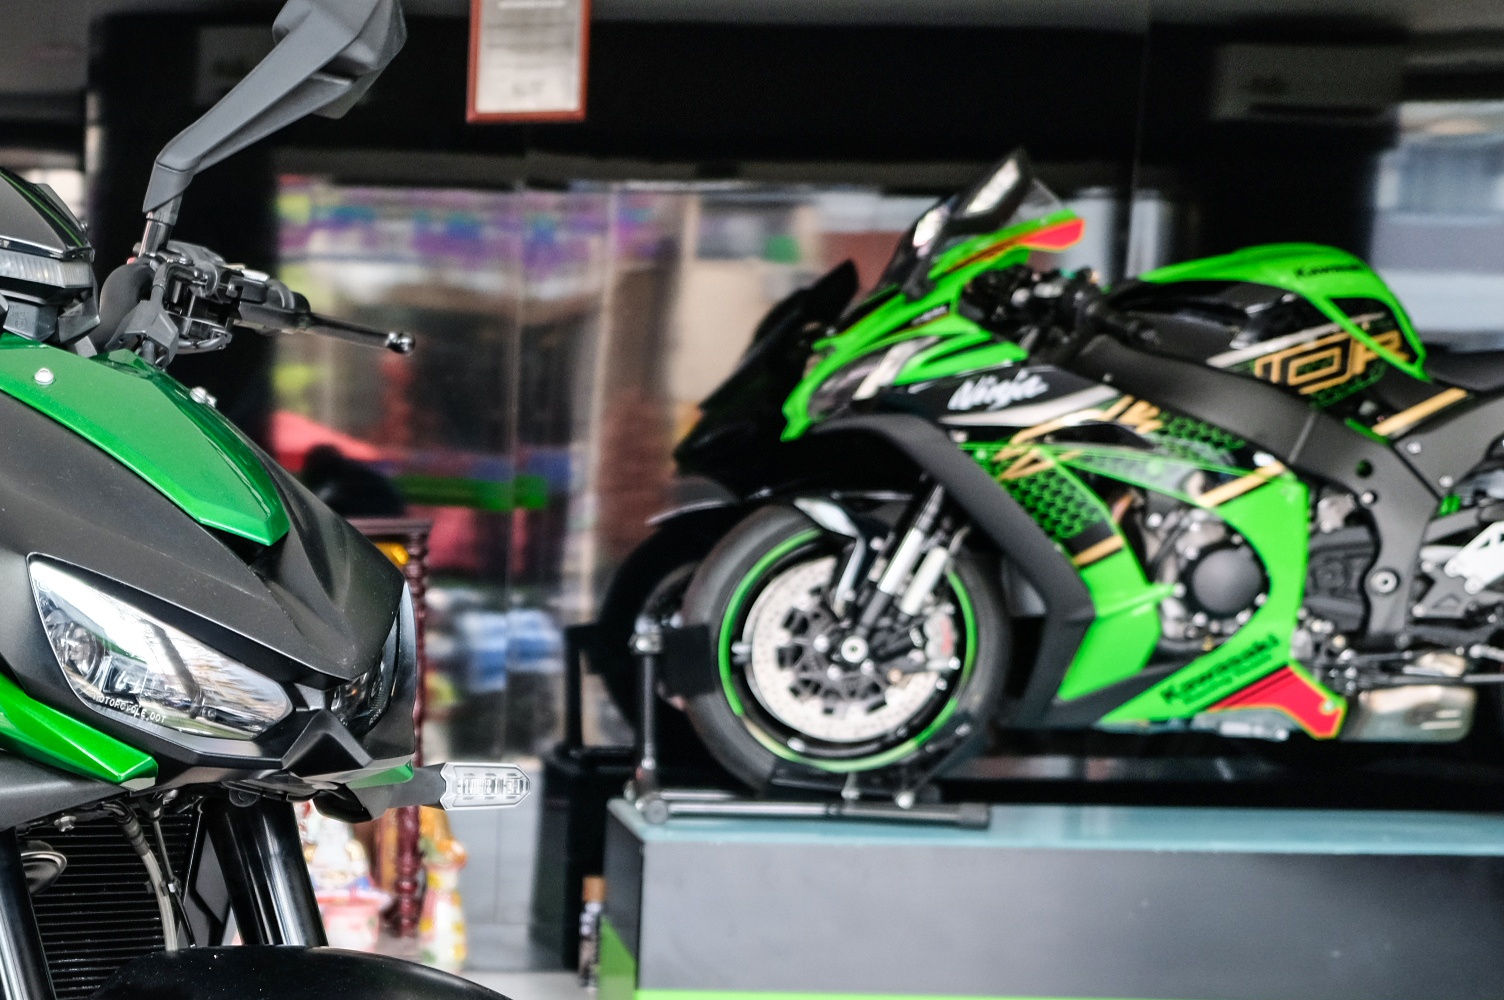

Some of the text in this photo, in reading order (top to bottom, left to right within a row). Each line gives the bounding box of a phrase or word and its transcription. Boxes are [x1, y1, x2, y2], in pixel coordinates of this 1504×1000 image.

[947, 367, 1050, 412] Ninja
[93, 694, 168, 724] MOTORCYCLE DOT
